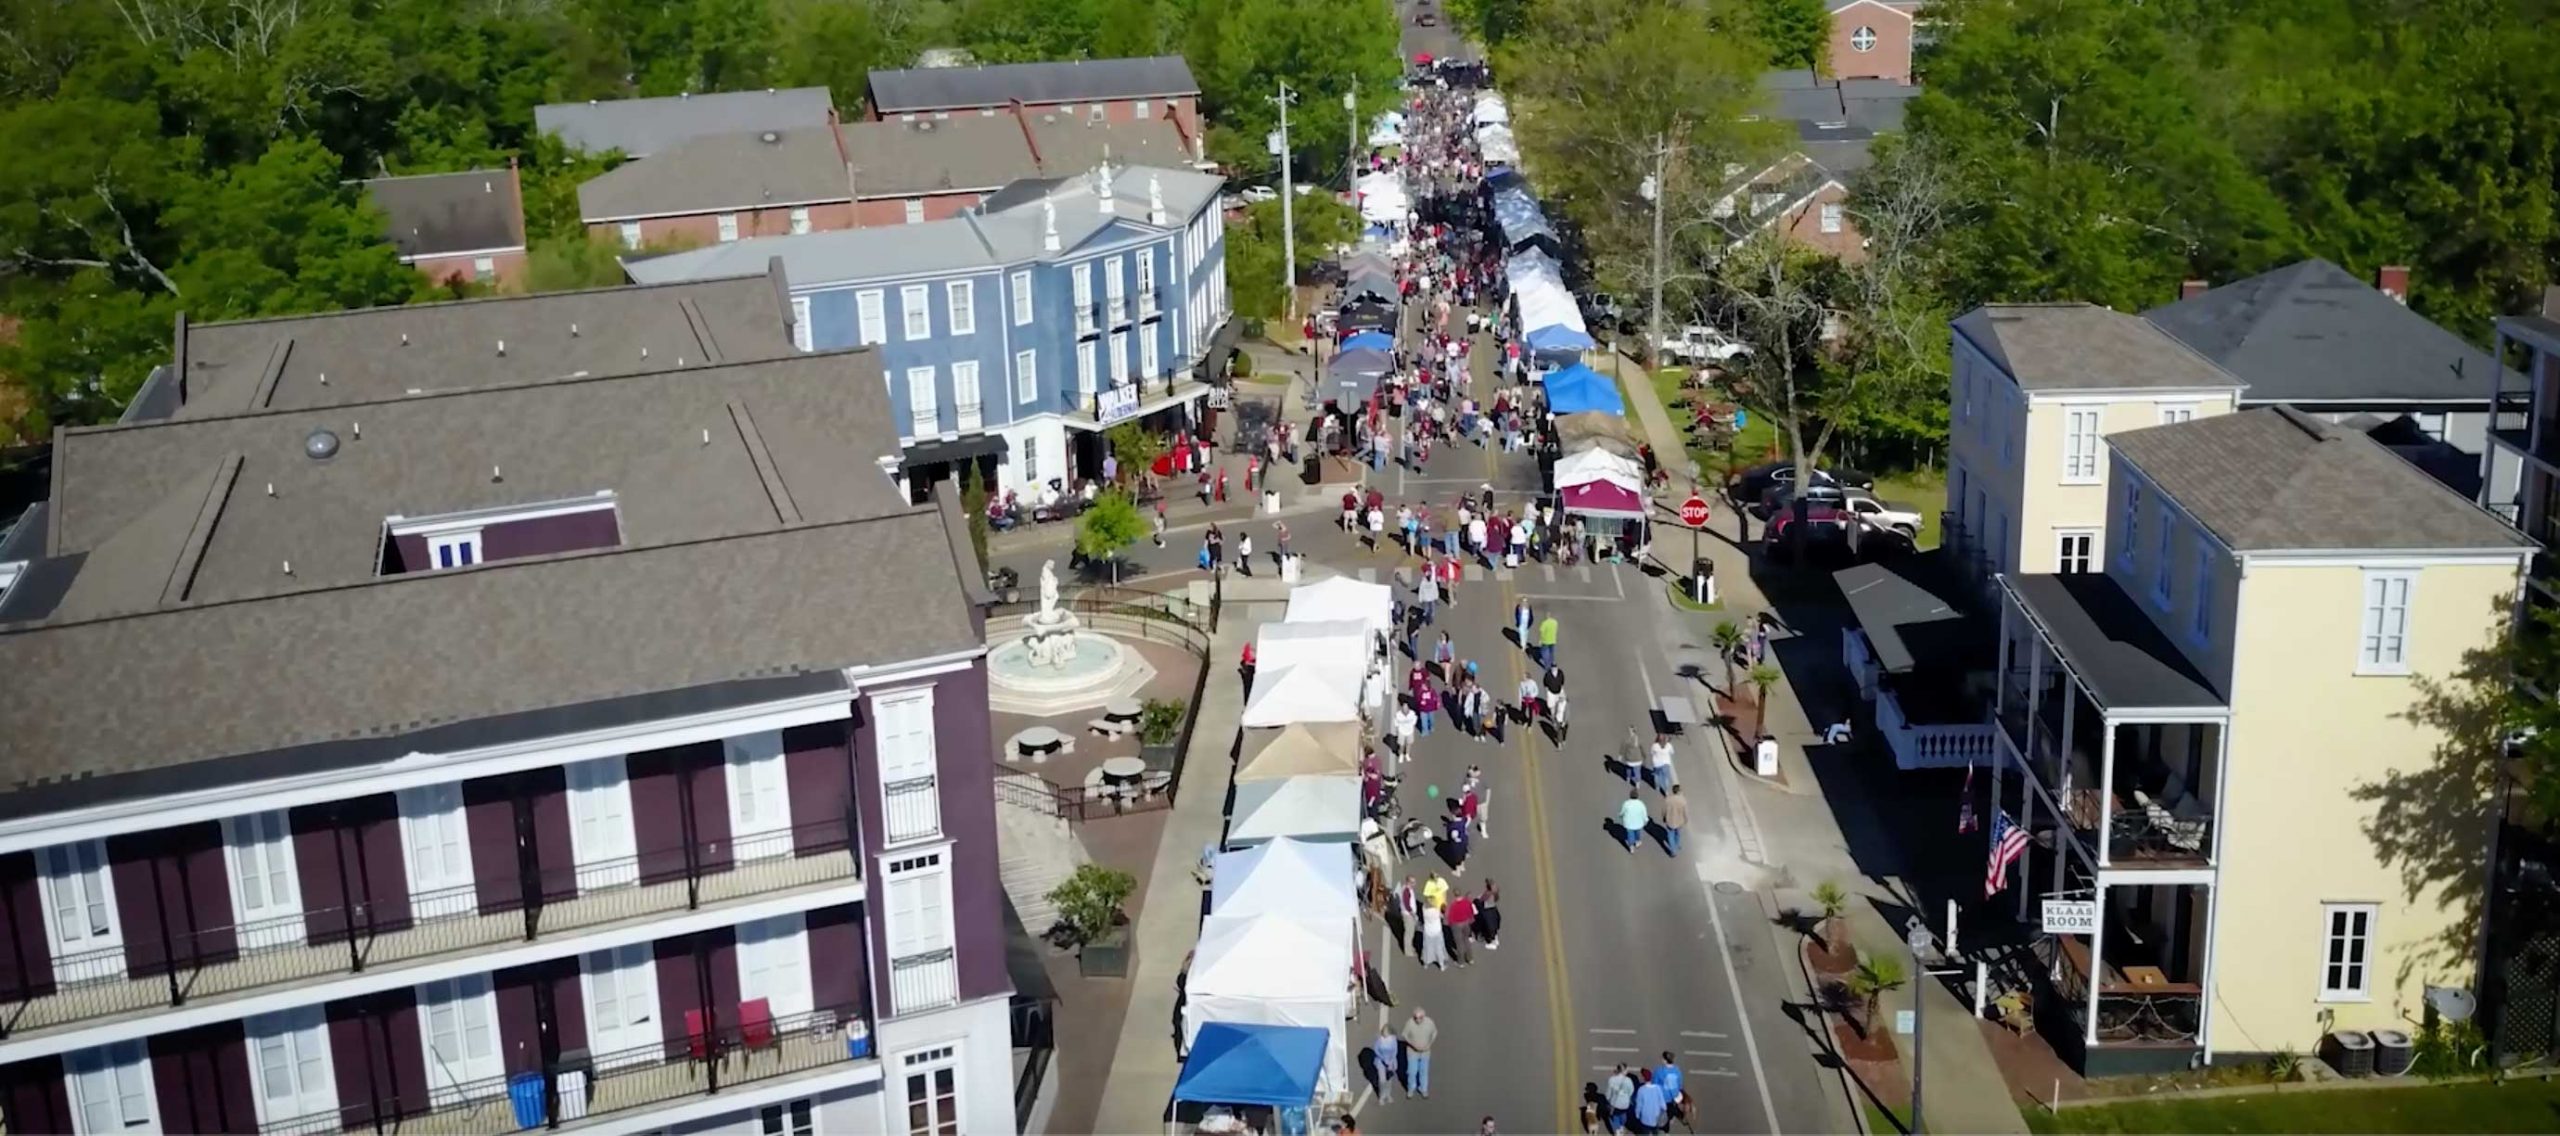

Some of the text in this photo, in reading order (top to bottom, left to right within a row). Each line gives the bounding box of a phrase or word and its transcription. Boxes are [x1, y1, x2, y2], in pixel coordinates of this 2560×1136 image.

[1682, 507, 1708, 518] STOP
[2046, 907, 2092, 915] KLAAS
[2047, 917, 2092, 926] ROOM
